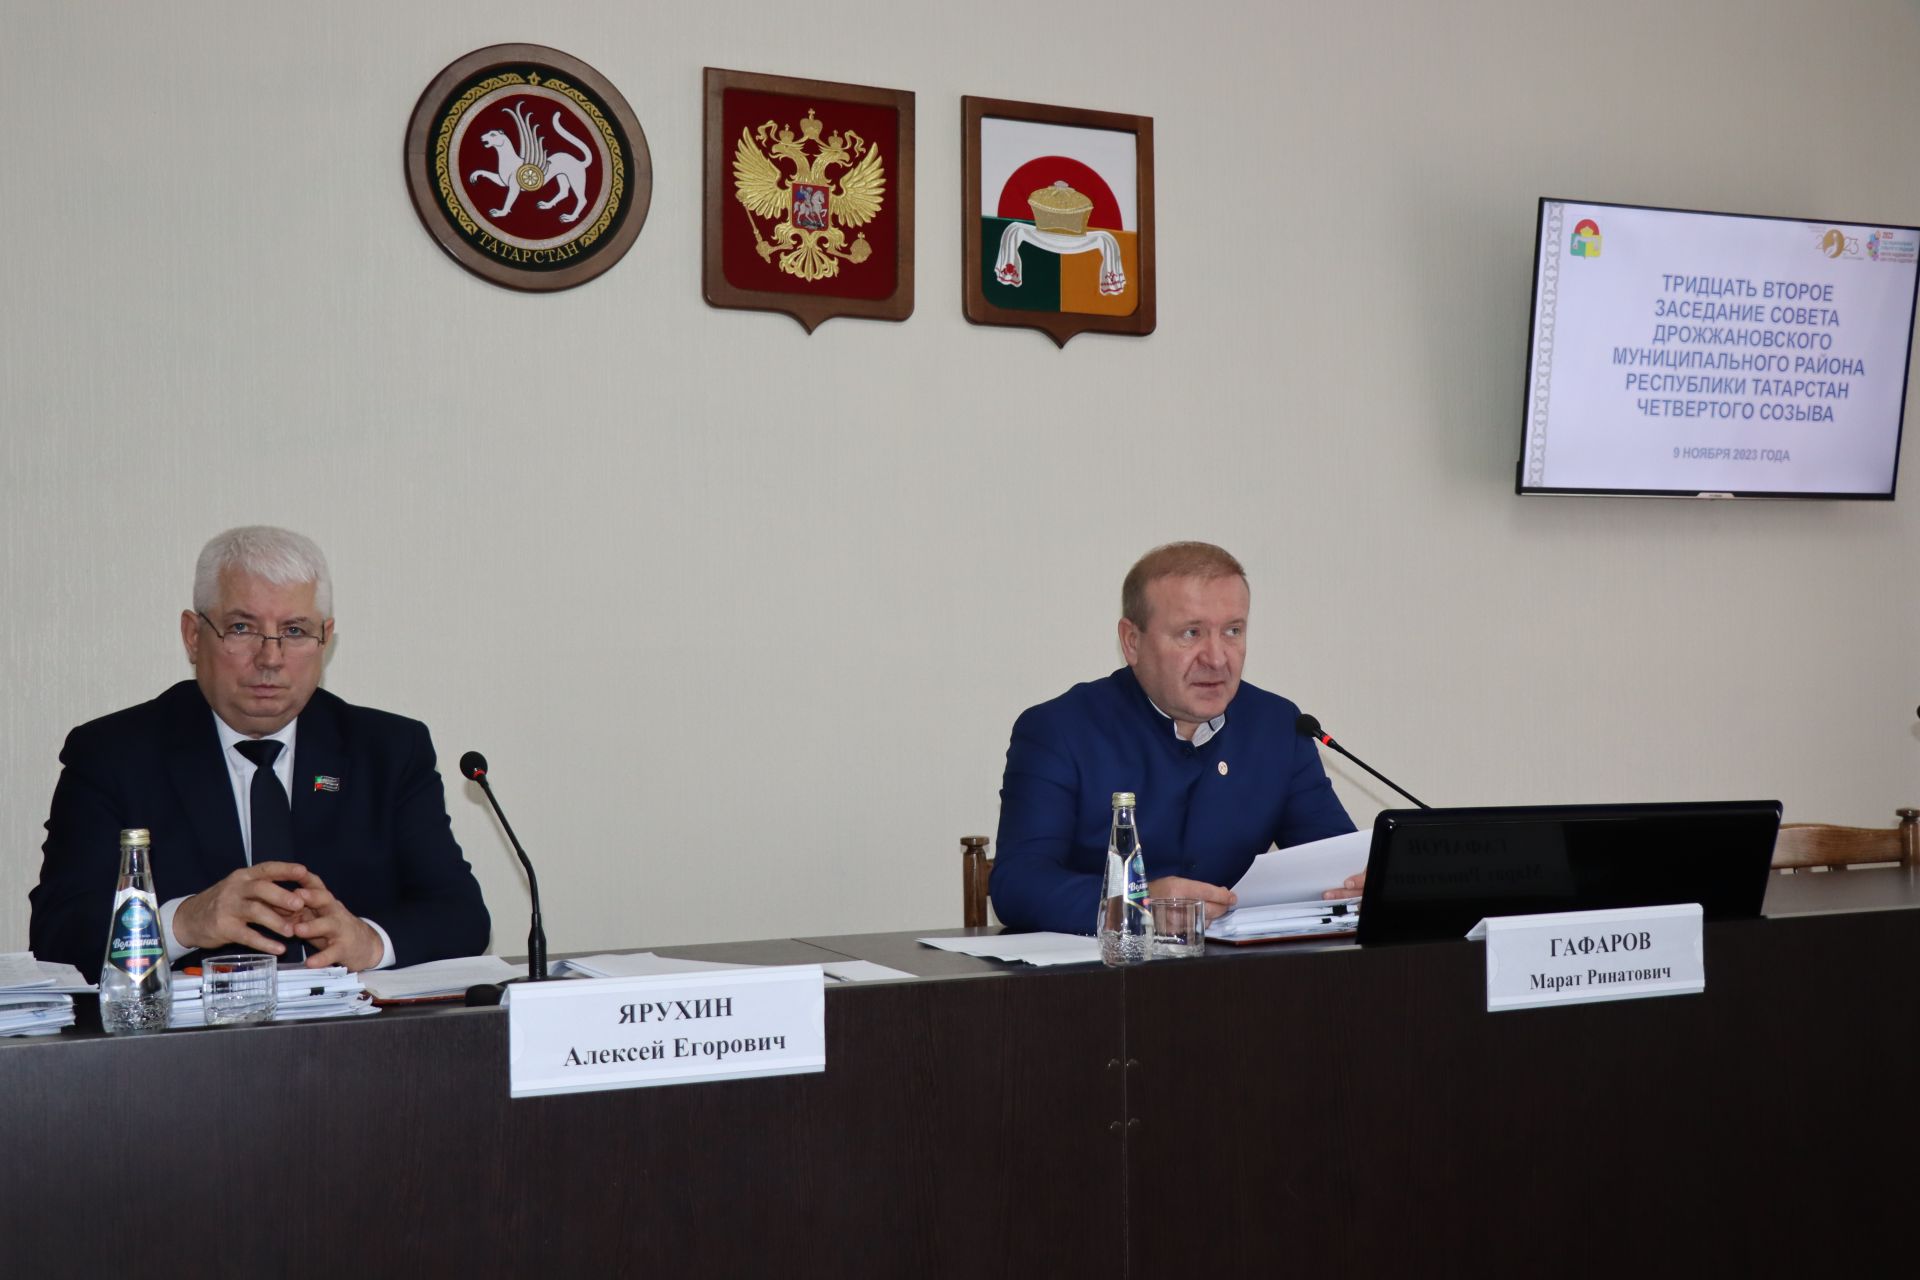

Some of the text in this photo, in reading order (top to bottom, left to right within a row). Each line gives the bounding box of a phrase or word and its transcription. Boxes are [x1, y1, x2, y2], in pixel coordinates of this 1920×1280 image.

[478, 232, 579, 263] ТАТАРСТАН
[1662, 274, 1833, 301] ТРИДЦАТЬ ВТОРОЕ
[1655, 299, 1839, 327] ЗАСЕДАНИЕ СОВЕТА
[1652, 324, 1832, 350] ДРОЖЖАНОВСКОГО
[1612, 347, 1865, 376] МУНИЦИПАЛЬНОГО РАЙОНА
[1625, 373, 1849, 399] РЕСПУБЛИКИ ТАТАРСТАН
[1637, 398, 1834, 422] ЧЕТВЕРТОГО СОЗЫВА
[1673, 447, 1790, 462] 9 НОЯБРЯ 2023 ГОДА
[1550, 931, 1651, 957] ГАФАРОВ
[1530, 967, 1671, 992] Марат Ринатович
[618, 997, 733, 1025] ЯРУХИН
[564, 1035, 786, 1067] Алексей Егорович
